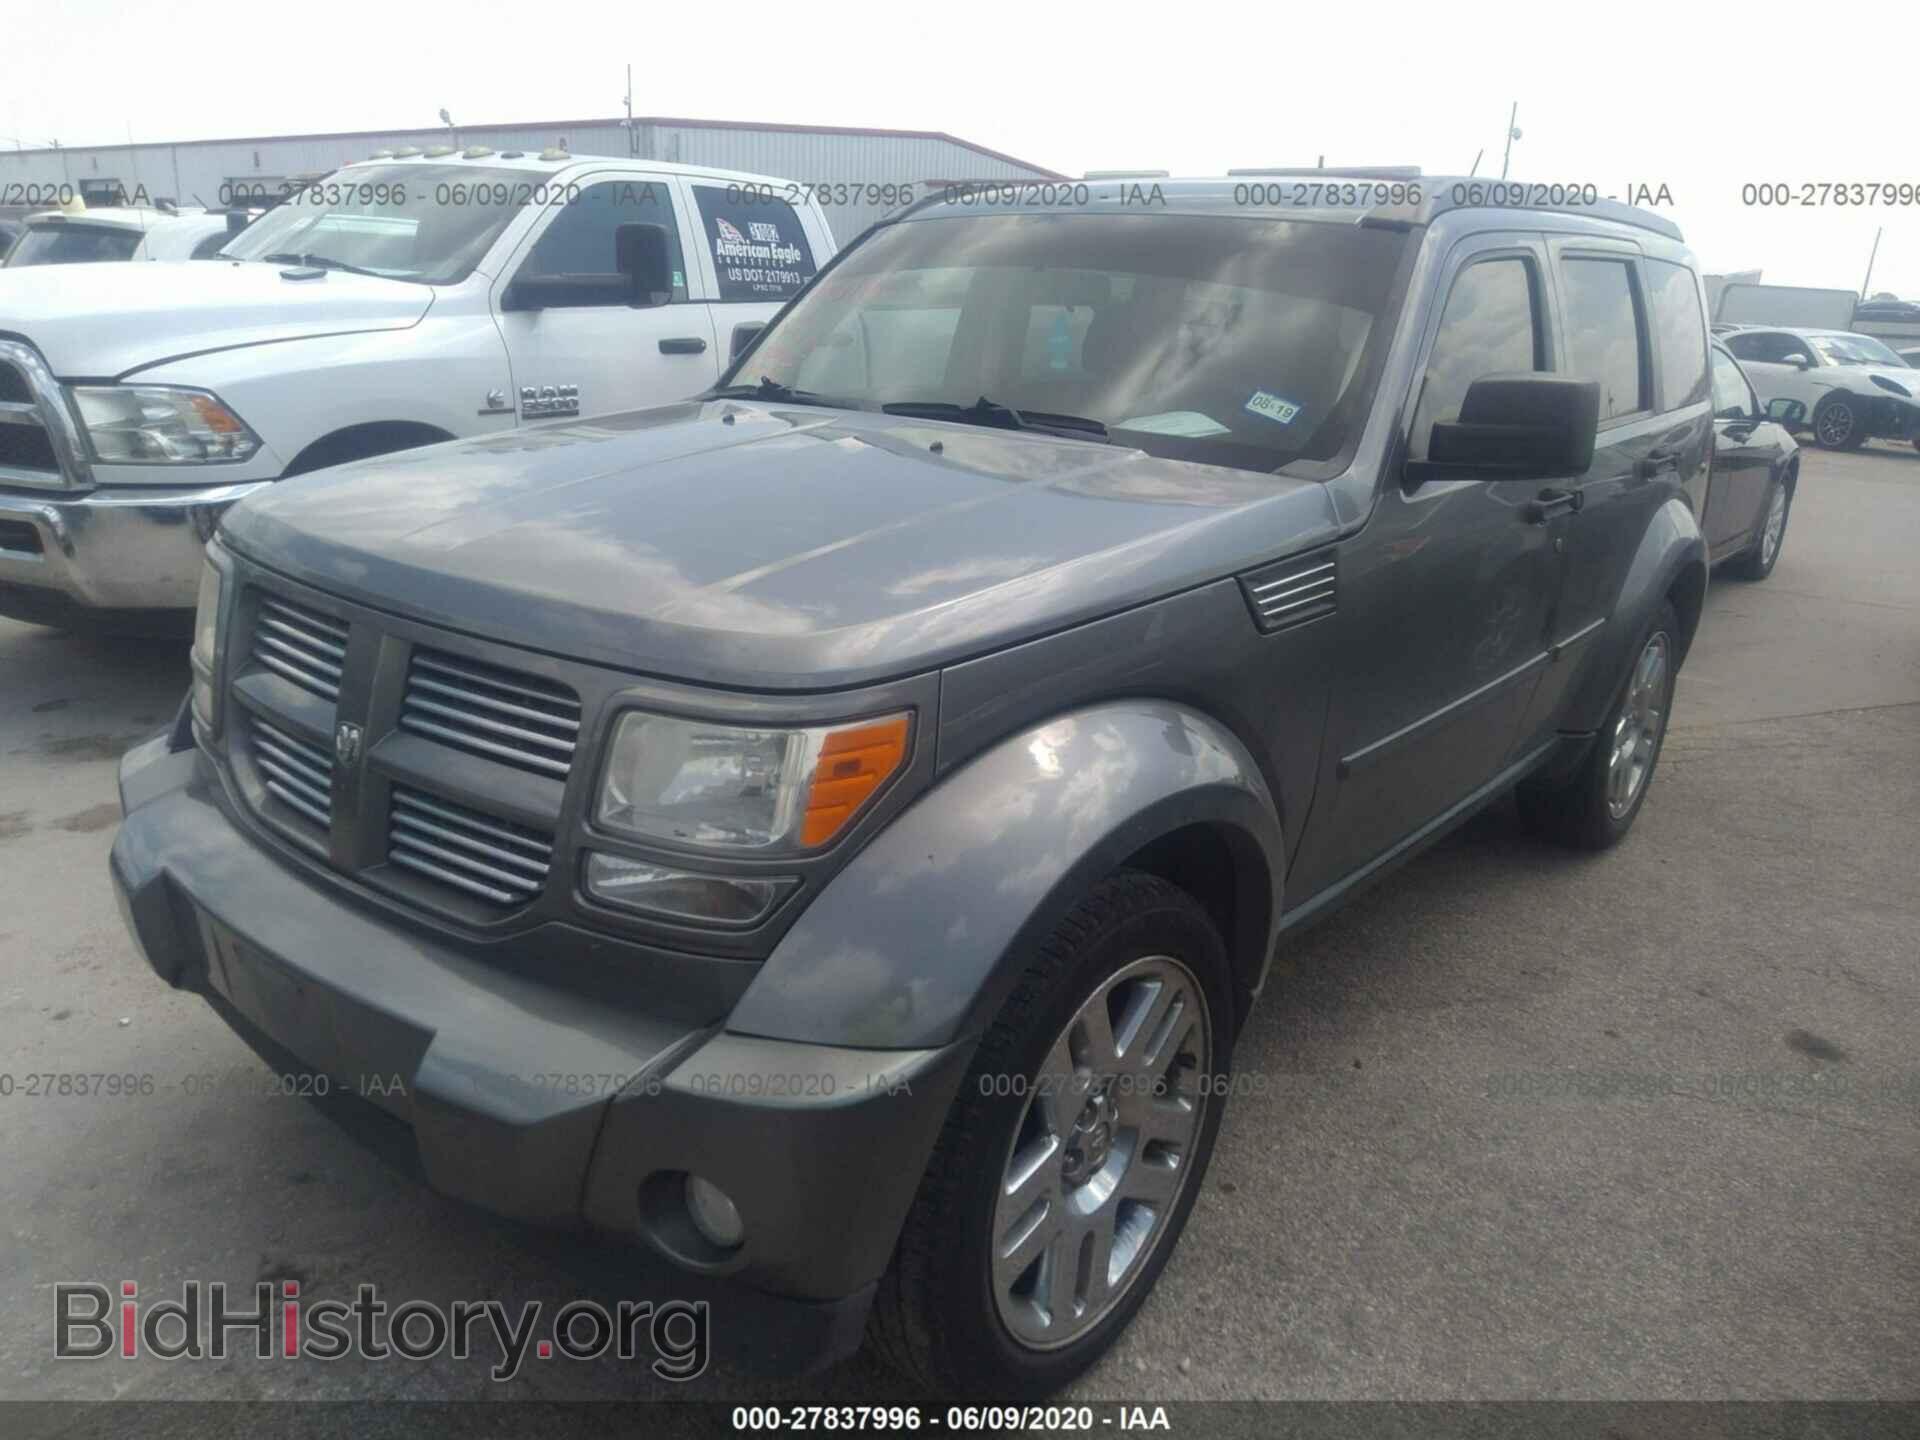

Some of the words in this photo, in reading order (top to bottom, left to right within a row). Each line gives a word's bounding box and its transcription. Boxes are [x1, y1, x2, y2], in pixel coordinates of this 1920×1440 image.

[716, 239, 770, 260] American
[770, 243, 801, 265] Eagle
[728, 267, 742, 281] US
[743, 268, 763, 282] DOT
